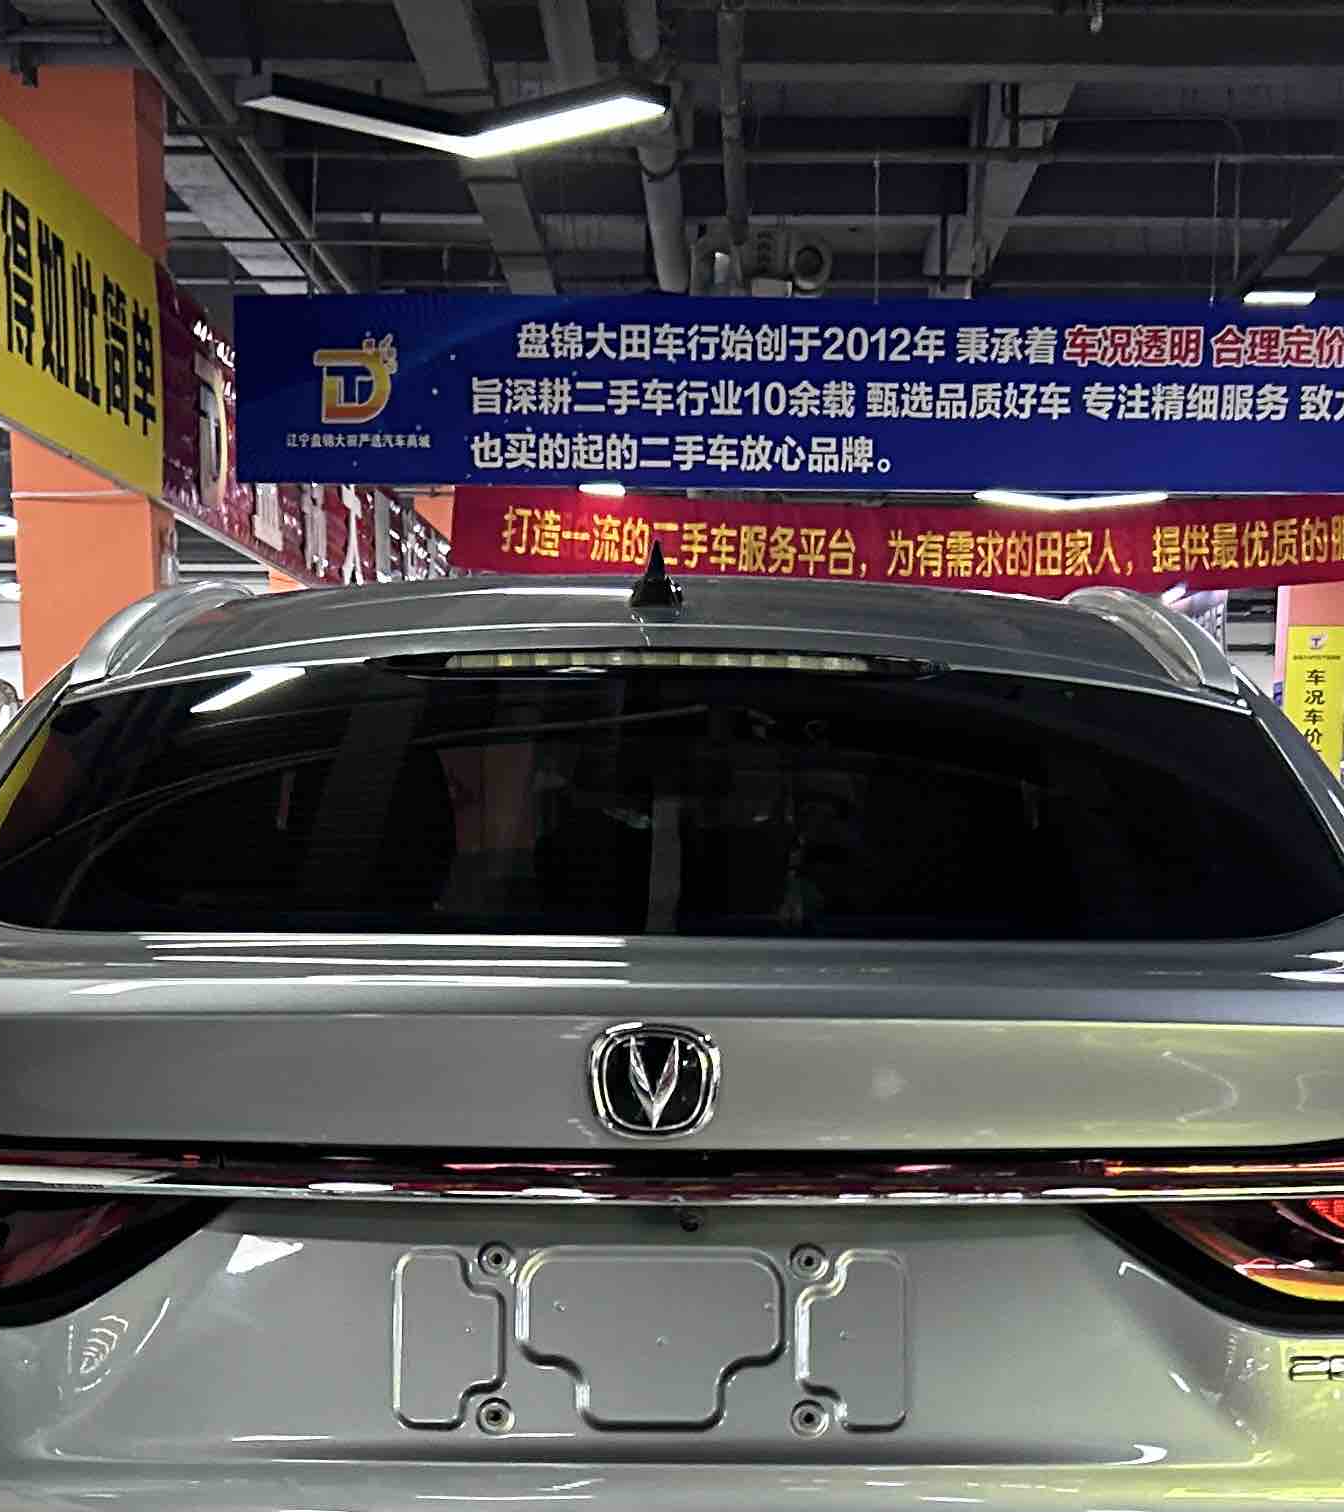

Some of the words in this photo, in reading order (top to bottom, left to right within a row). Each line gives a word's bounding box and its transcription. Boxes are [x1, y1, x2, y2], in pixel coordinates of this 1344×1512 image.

[516, 322, 946, 365] 盘锦大田车行始创于2012年
[956, 326, 1058, 365] 秉承着
[1063, 324, 1204, 367] 车况透明
[471, 376, 856, 419] 旨深耕二手车行业10余载
[865, 381, 1072, 420] 甄选品质好车
[1082, 383, 1289, 421] 专注精细服务
[471, 431, 892, 473] 也买的起的二手车放心品牌。
[1303, 669, 1326, 752] 车况车价
